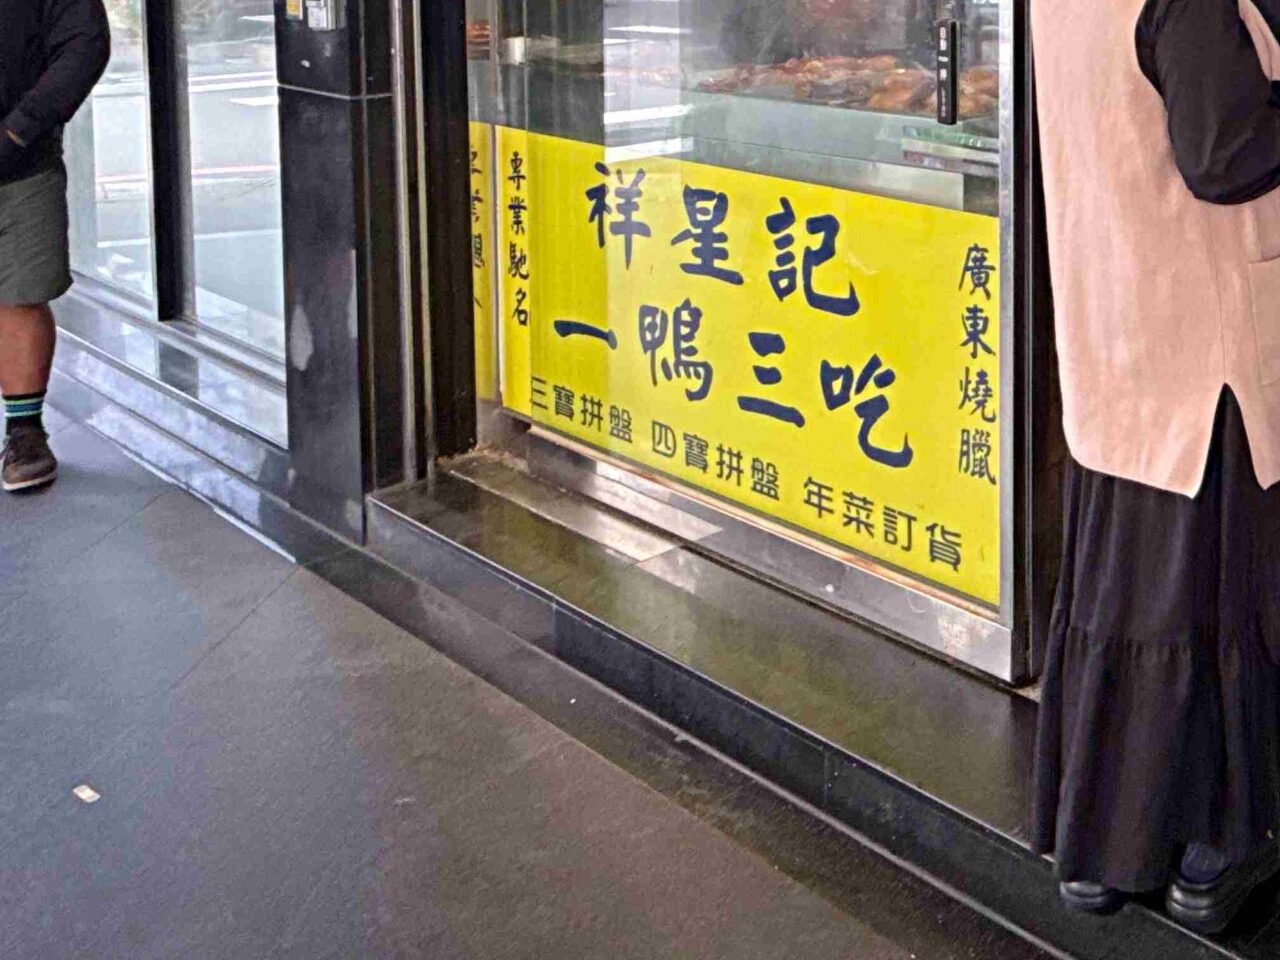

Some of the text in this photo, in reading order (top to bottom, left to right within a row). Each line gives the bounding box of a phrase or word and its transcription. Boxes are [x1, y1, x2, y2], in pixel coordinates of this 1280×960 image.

[508, 151, 530, 326] 專業馳名
[585, 162, 860, 316] 祥星記
[553, 297, 914, 468] 一鴨三吃
[958, 243, 997, 486] 廣東燒臘
[530, 376, 962, 572] 三寶拼盤 四寶拼盤 年菜訂貨
